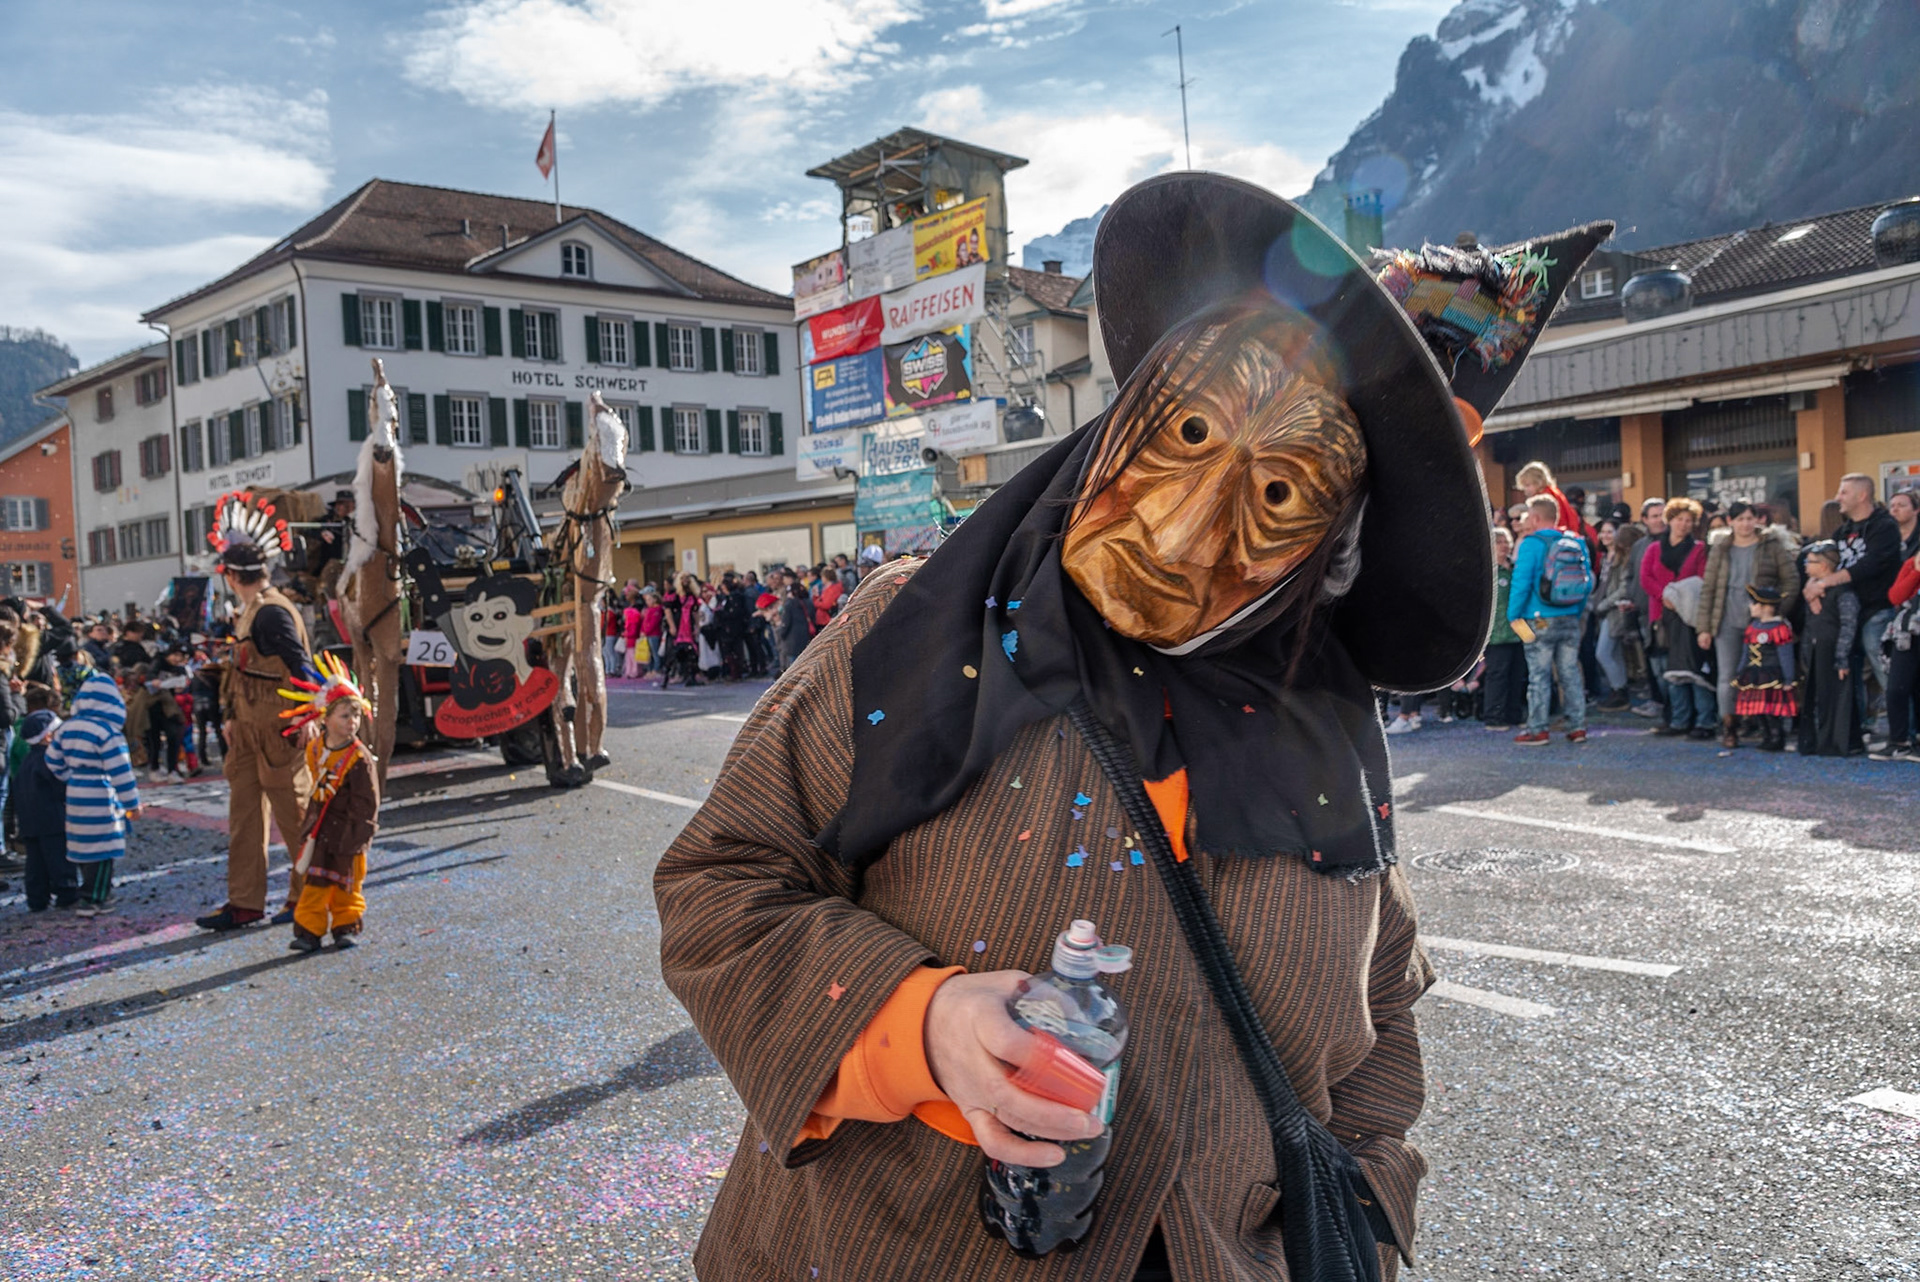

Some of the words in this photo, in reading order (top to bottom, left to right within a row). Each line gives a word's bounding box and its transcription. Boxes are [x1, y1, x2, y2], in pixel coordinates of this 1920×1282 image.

[889, 283, 974, 330] RAIFFEISEN
[903, 353, 944, 376] SWISS
[512, 371, 564, 387] HOTEL
[575, 375, 648, 392] SCHWERT
[868, 437, 920, 459] HAUSER
[236, 464, 271, 486] SCHWERT
[416, 641, 447, 662] 26
